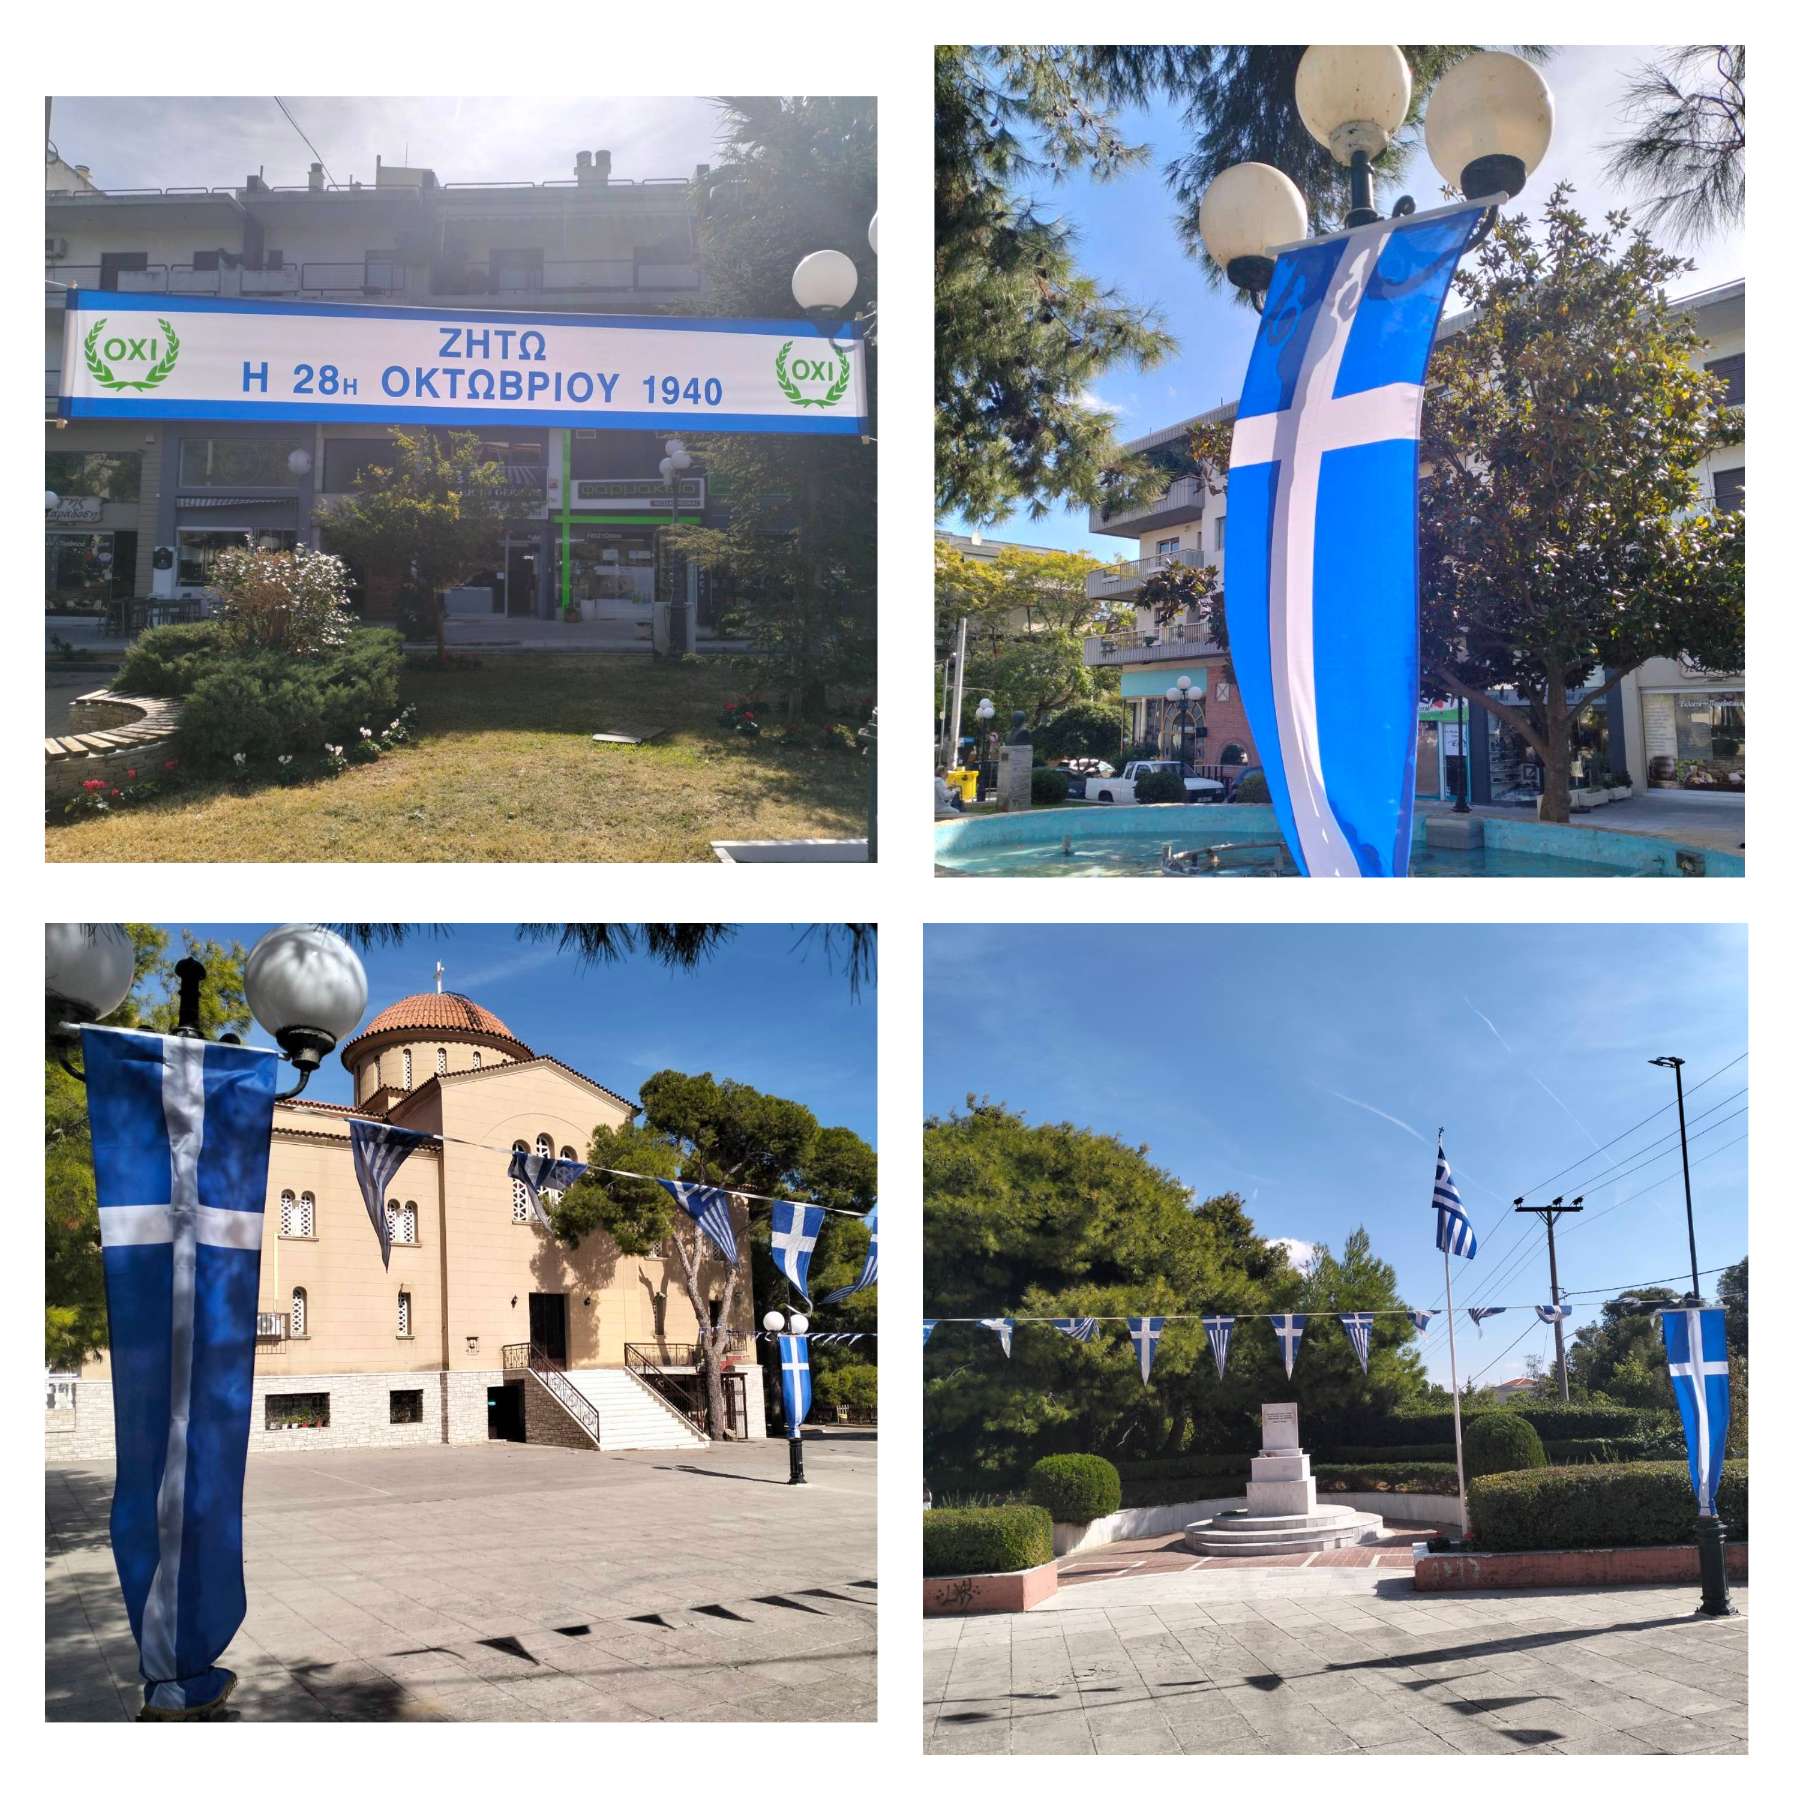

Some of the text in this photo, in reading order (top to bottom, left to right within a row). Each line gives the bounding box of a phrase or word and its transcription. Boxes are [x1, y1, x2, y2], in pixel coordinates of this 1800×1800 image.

[103, 337, 158, 362] ΟΧΙ
[438, 328, 546, 361] ΖΗΤΩ
[241, 361, 269, 393] Η
[381, 366, 620, 403] ΟΚΤΩΒΡΙΟΥ
[643, 375, 724, 406] 1940
[792, 359, 834, 382] ΟΧΙ
